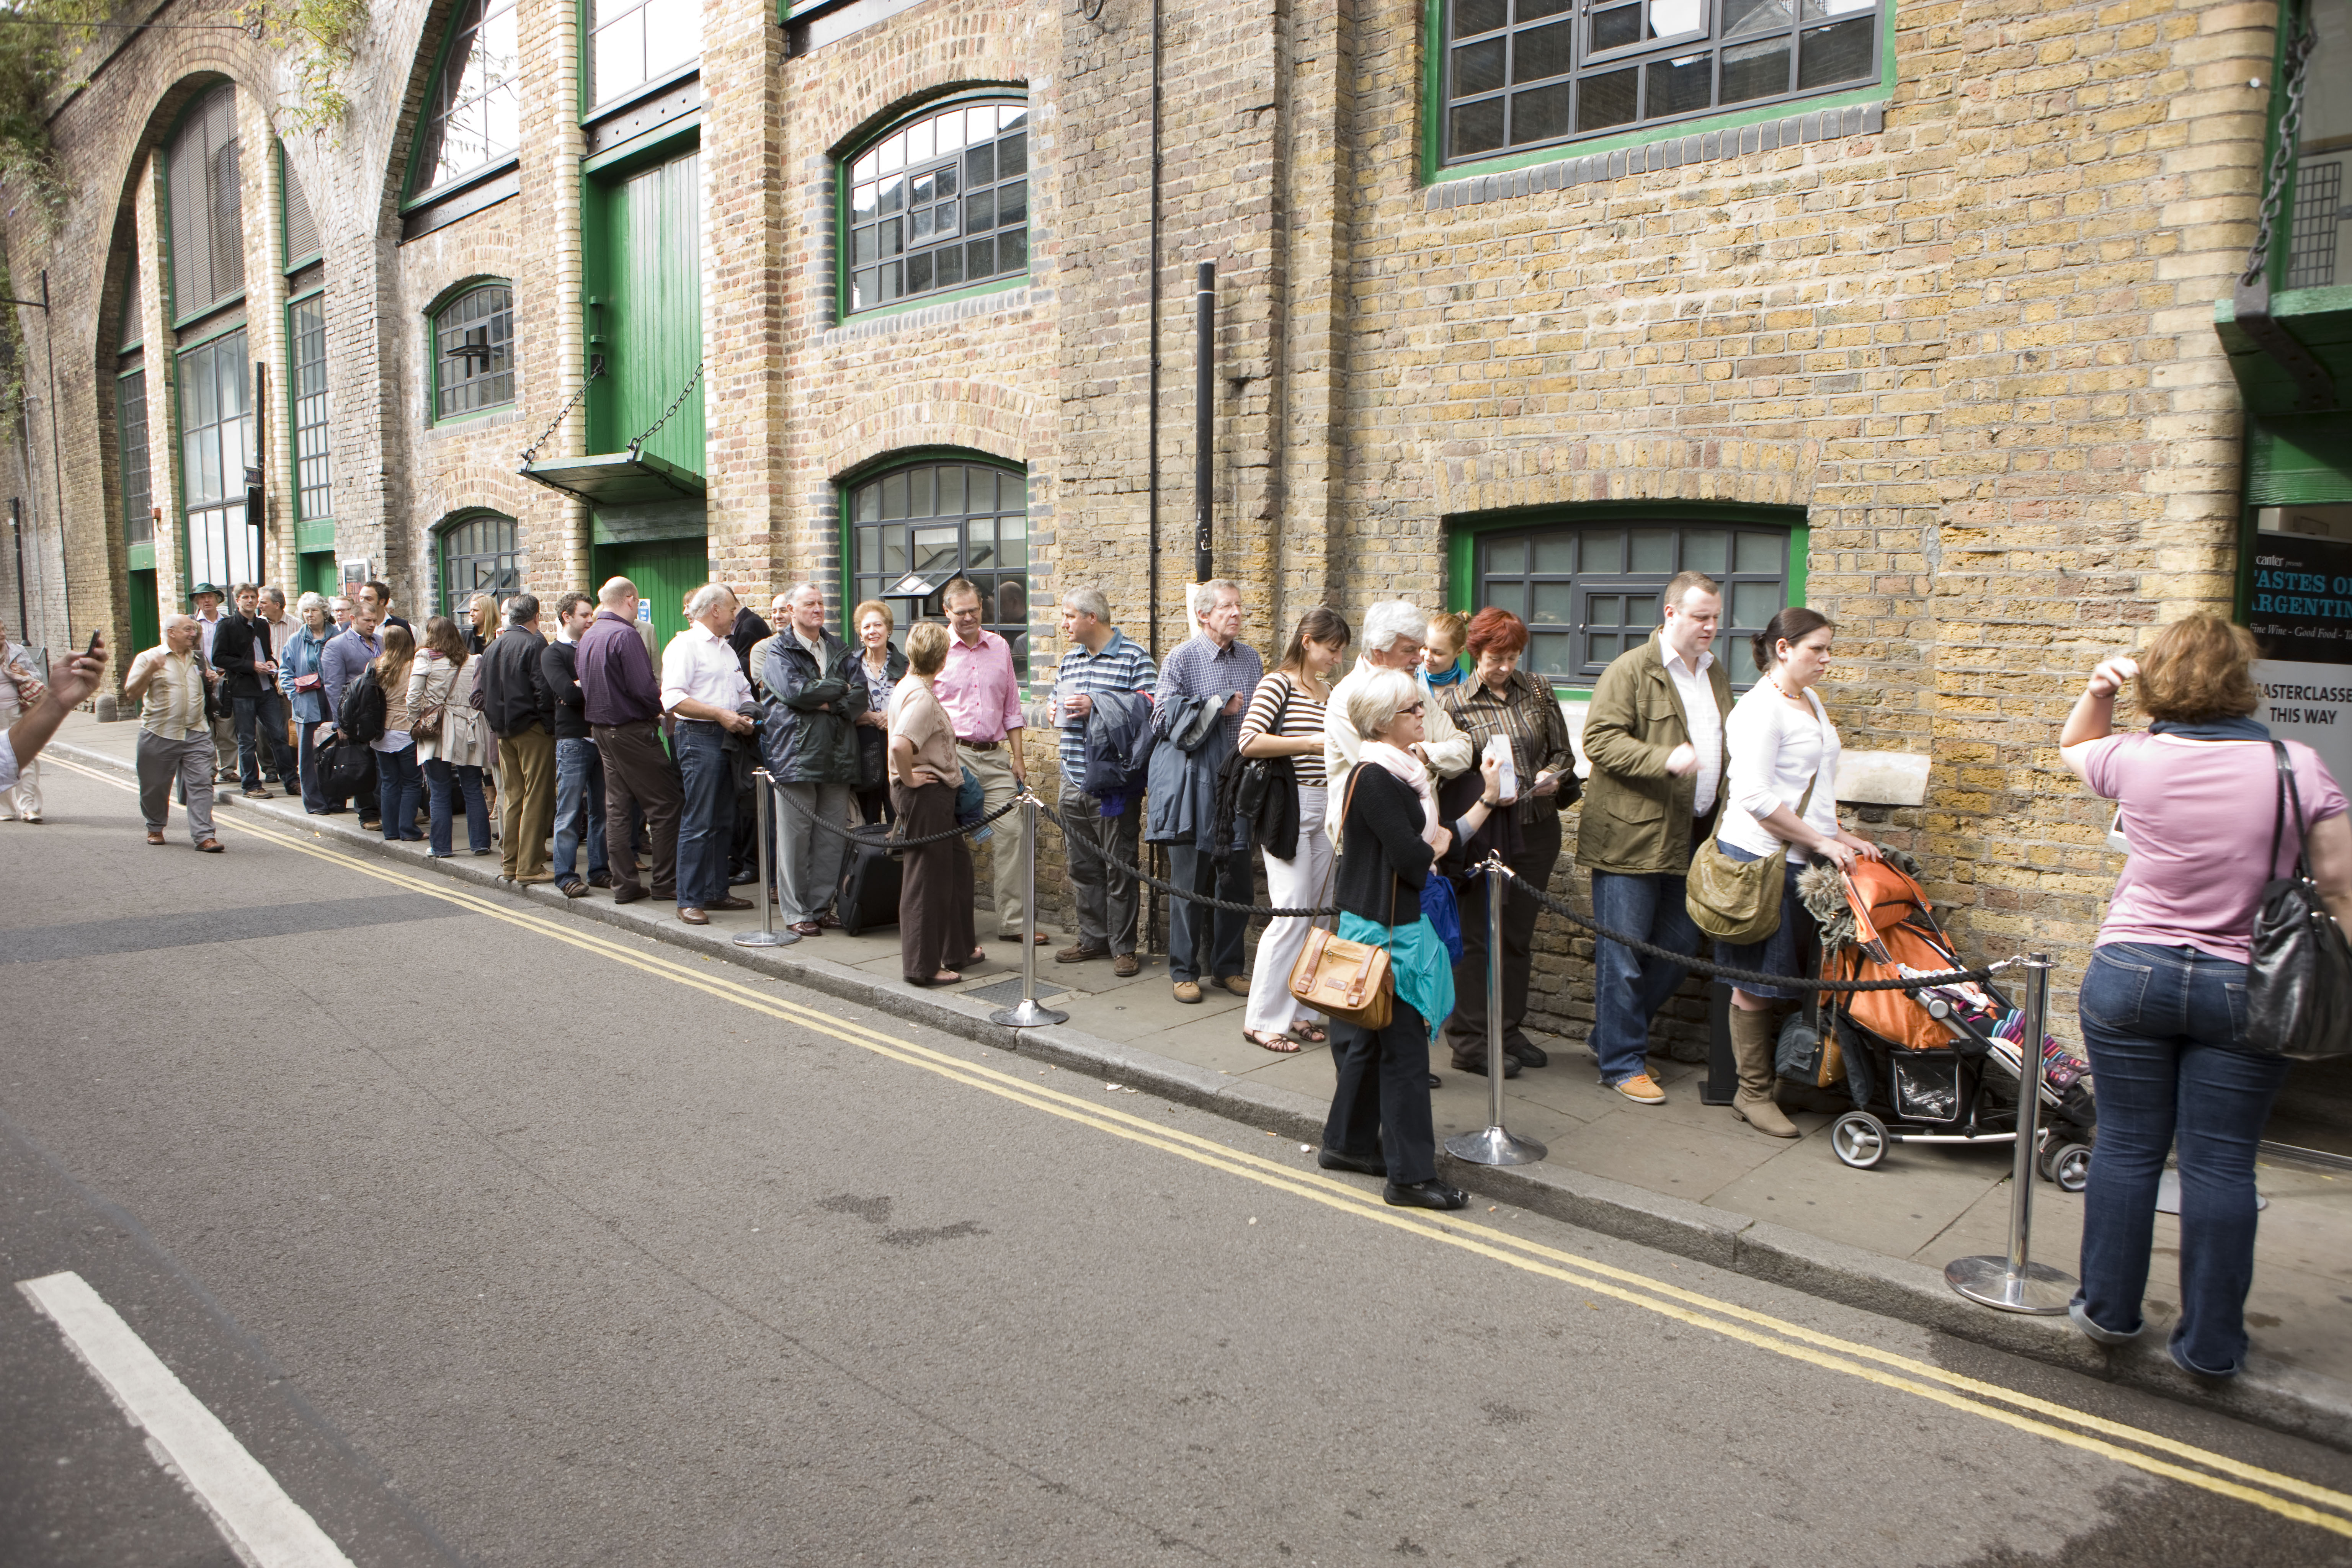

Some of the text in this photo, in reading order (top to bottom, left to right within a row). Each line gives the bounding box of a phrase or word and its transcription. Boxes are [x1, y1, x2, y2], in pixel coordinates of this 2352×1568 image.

[2255, 555, 2284, 567] canter
[2268, 624, 2287, 635] Wine
[2295, 626, 2315, 637] Good
[2318, 628, 2337, 639] Food
[2270, 707, 2337, 724] THIS WAY
